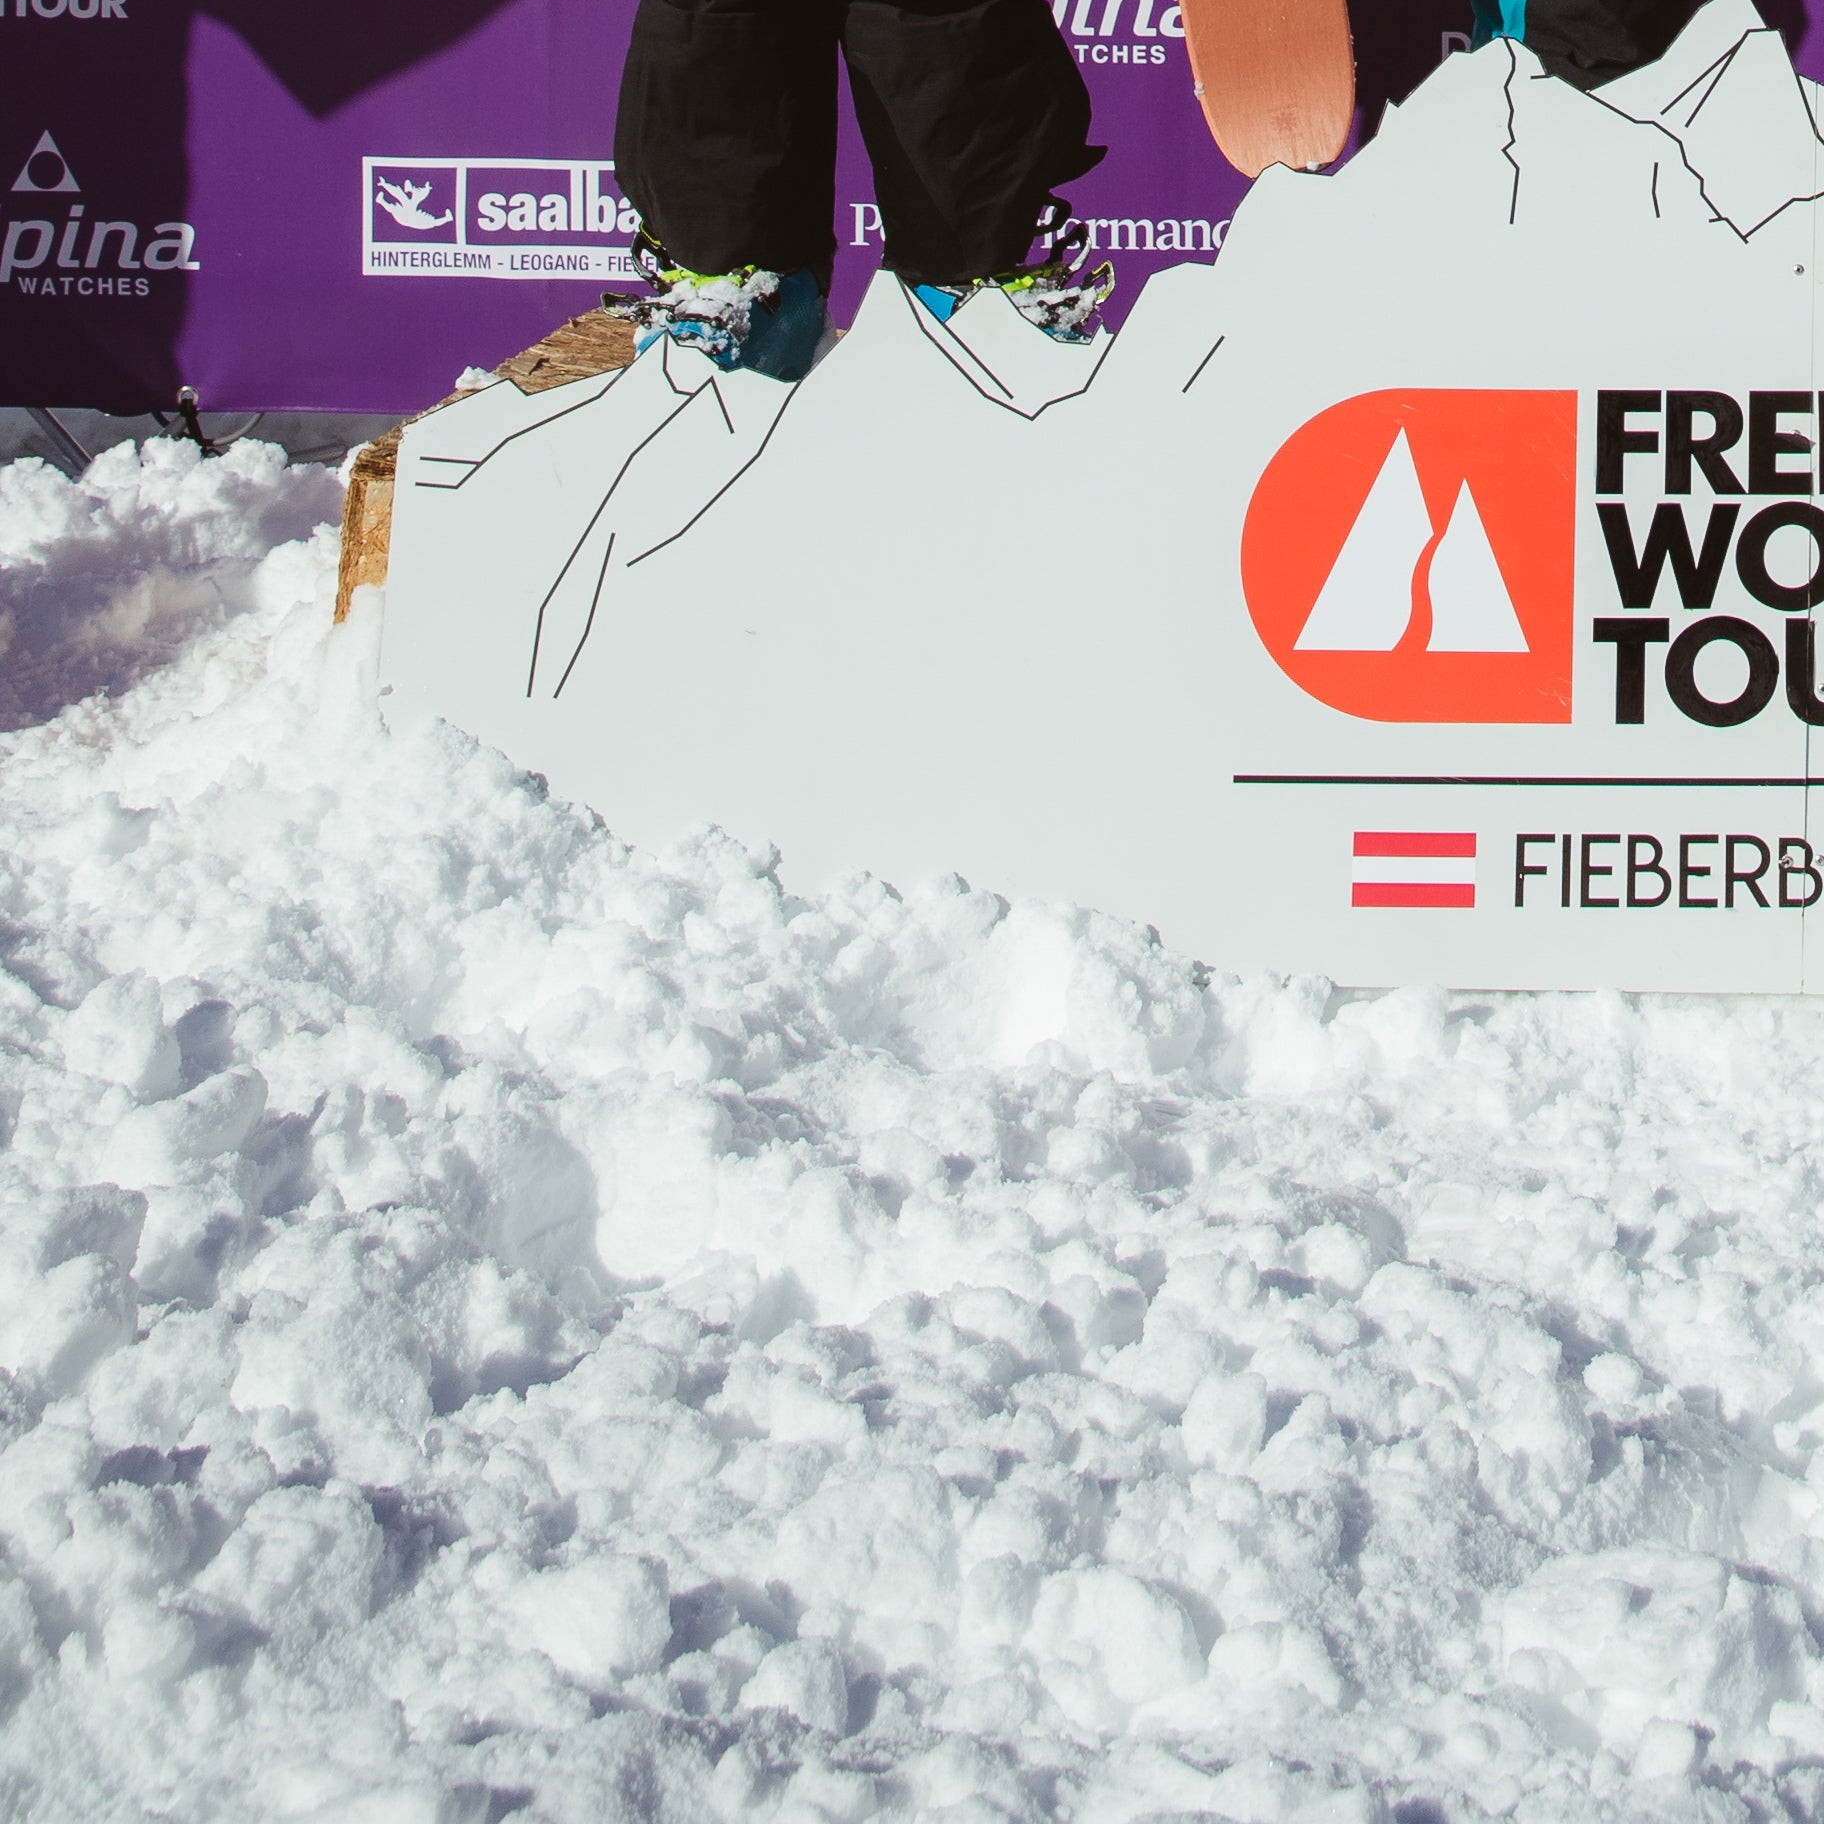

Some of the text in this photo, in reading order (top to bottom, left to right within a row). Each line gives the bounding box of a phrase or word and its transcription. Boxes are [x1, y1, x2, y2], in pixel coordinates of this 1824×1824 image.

[371, 250, 491, 271] HINTERGLEMM
[510, 252, 589, 271] LEOGANG
[19, 277, 150, 297] WATCHES
